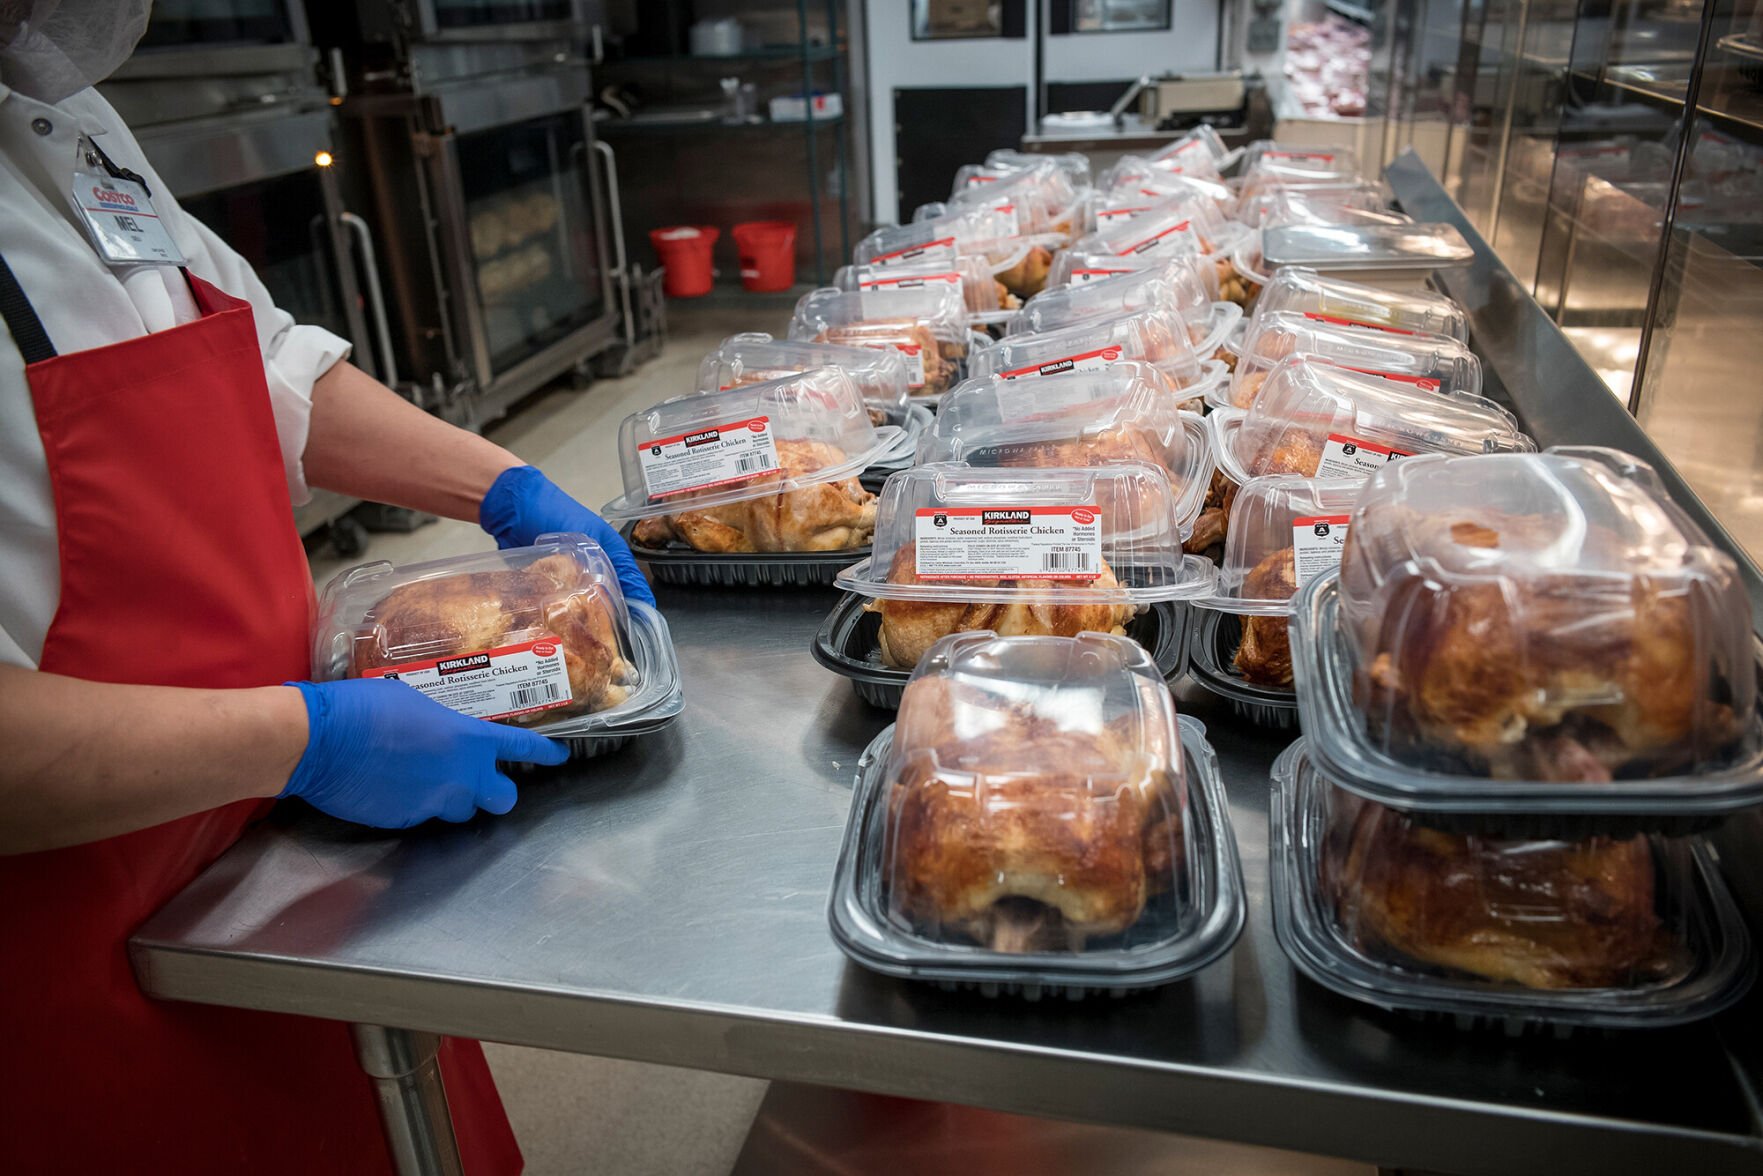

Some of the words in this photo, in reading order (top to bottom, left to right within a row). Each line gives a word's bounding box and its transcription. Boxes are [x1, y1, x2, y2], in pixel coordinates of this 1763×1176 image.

[93, 187, 135, 205] COSTCO
[113, 215, 144, 233] MEL
[1040, 360, 1073, 374] KIRKLAND
[685, 431, 718, 444] KIRKLAND
[664, 450, 691, 460] Seasoned
[691, 444, 720, 456] Rotisserie
[720, 438, 747, 449] Chicken
[984, 511, 1030, 520] KIRKLAND
[950, 527, 986, 536] Seasoned
[988, 526, 1028, 535] Rotisserie
[1030, 526, 1065, 535] Chicken
[439, 655, 489, 671] KIRKLAND
[537, 662, 560, 670] Hormones
[411, 677, 445, 690] asoned
[448, 671, 490, 684] Rotisserie
[492, 664, 528, 677] Chicken
[542, 667, 561, 675] Steroids
[517, 682, 531, 690] ITEM
[531, 679, 549, 687] 87745
